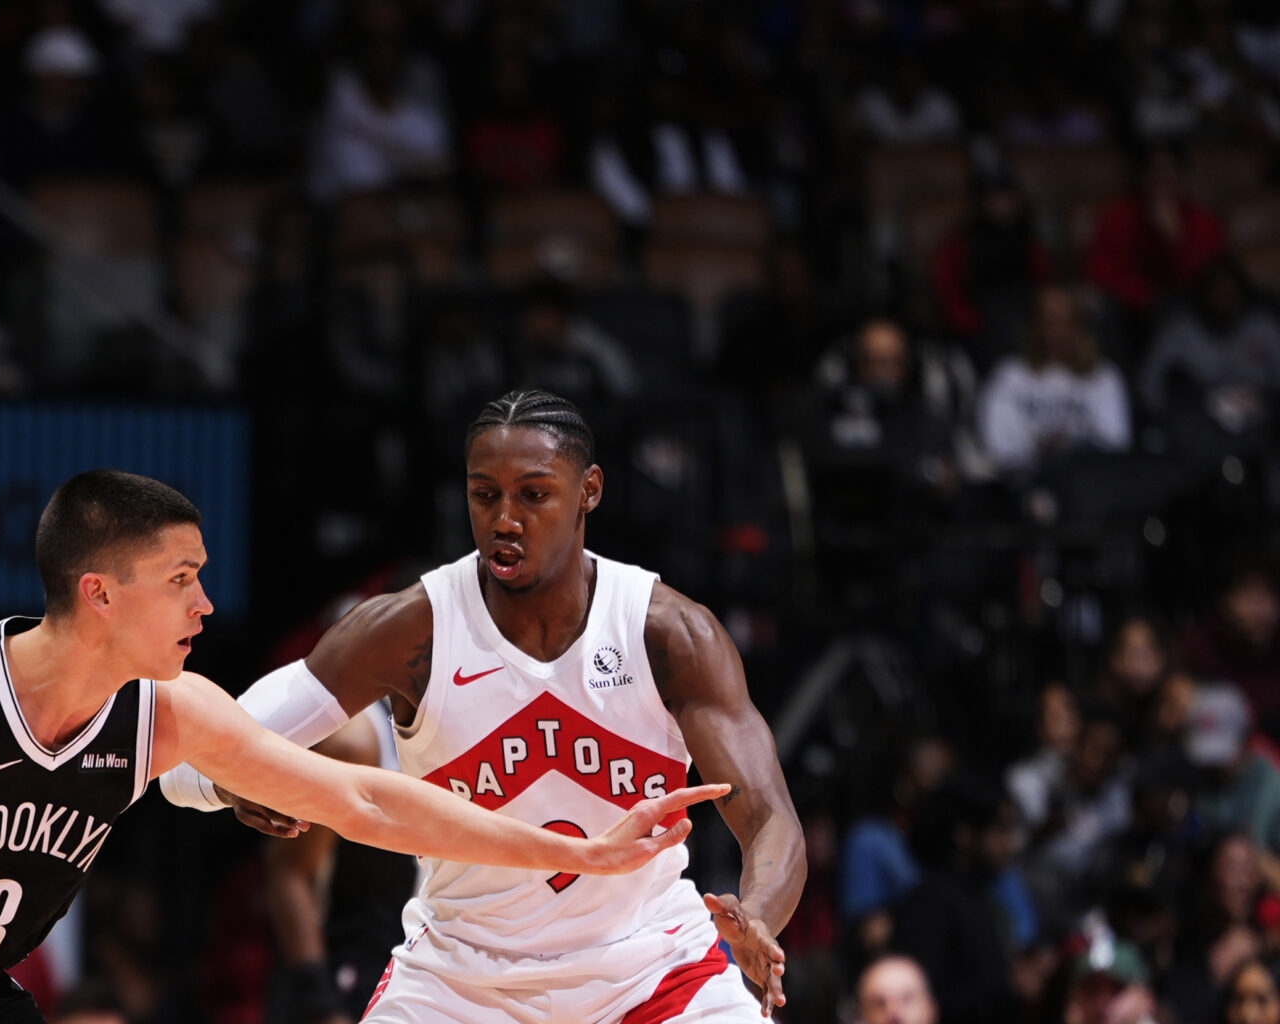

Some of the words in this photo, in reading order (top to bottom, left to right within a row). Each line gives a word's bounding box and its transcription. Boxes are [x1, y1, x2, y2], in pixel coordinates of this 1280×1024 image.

[588, 678, 610, 689] Sun
[612, 673, 633, 687] Life
[81, 753, 95, 769] All
[95, 753, 105, 769] In
[106, 753, 128, 769] Won
